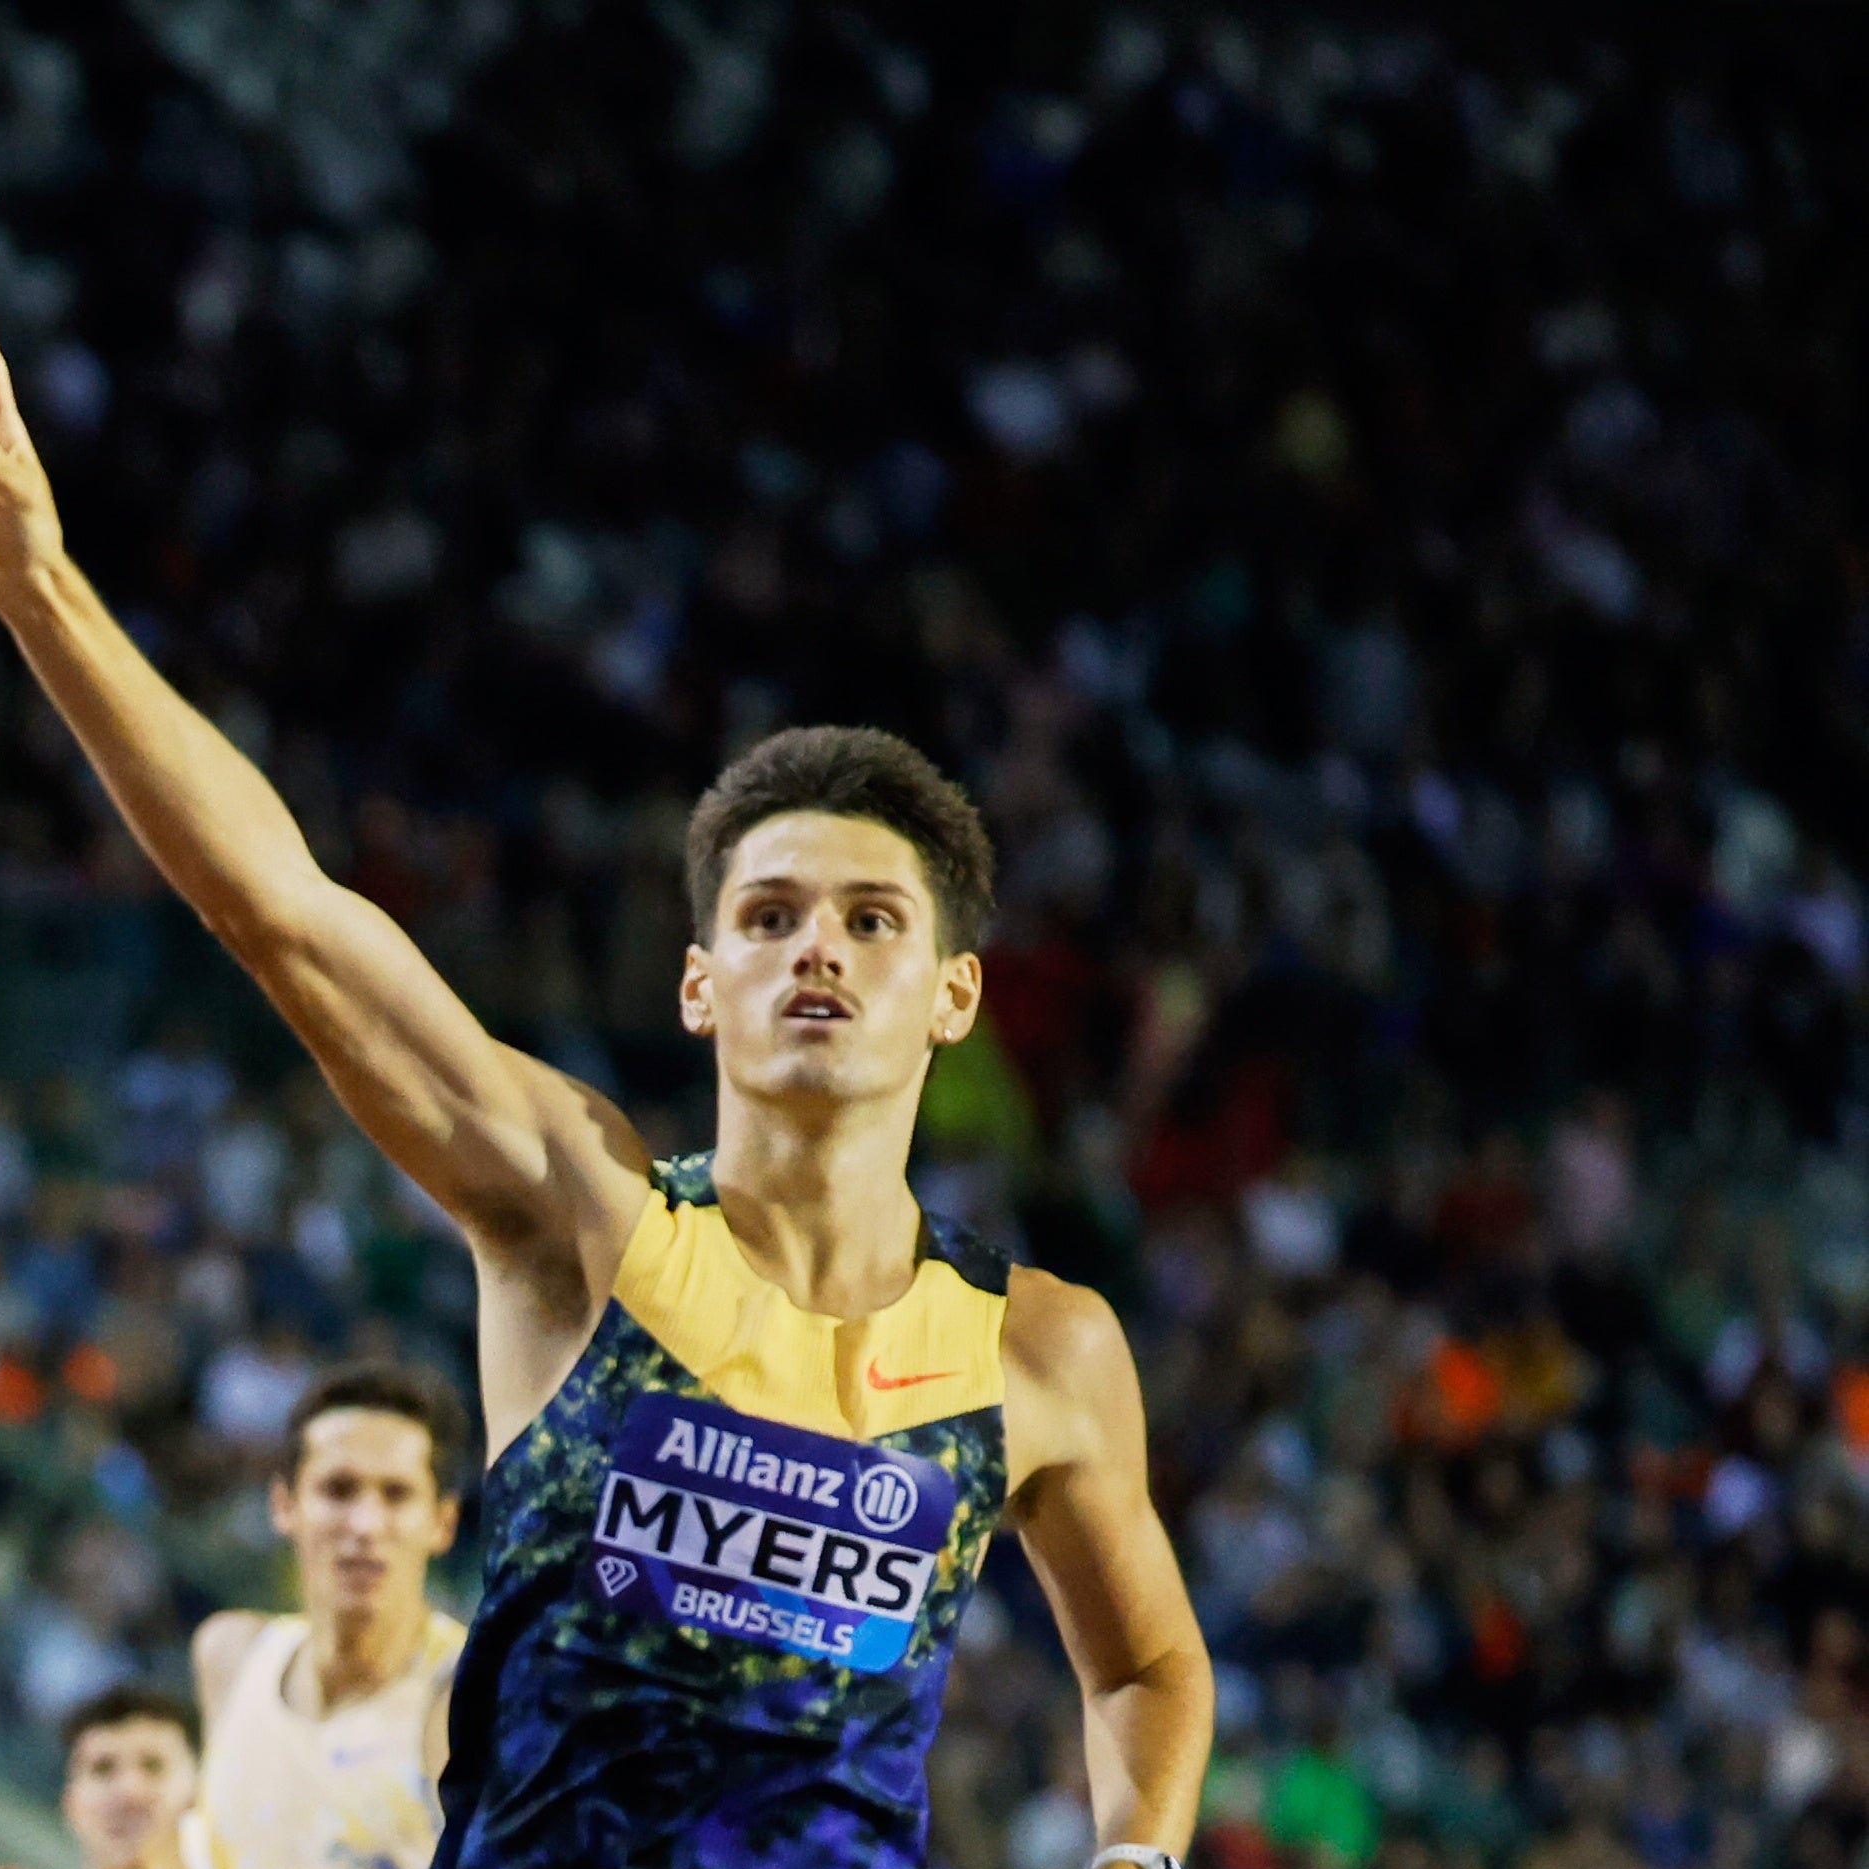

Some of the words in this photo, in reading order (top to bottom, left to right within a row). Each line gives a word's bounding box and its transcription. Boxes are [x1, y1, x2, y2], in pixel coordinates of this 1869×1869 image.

[656, 1416, 846, 1510] Allianz
[602, 1480, 923, 1611] MYERS
[672, 1581, 855, 1657] BRUSSELS
